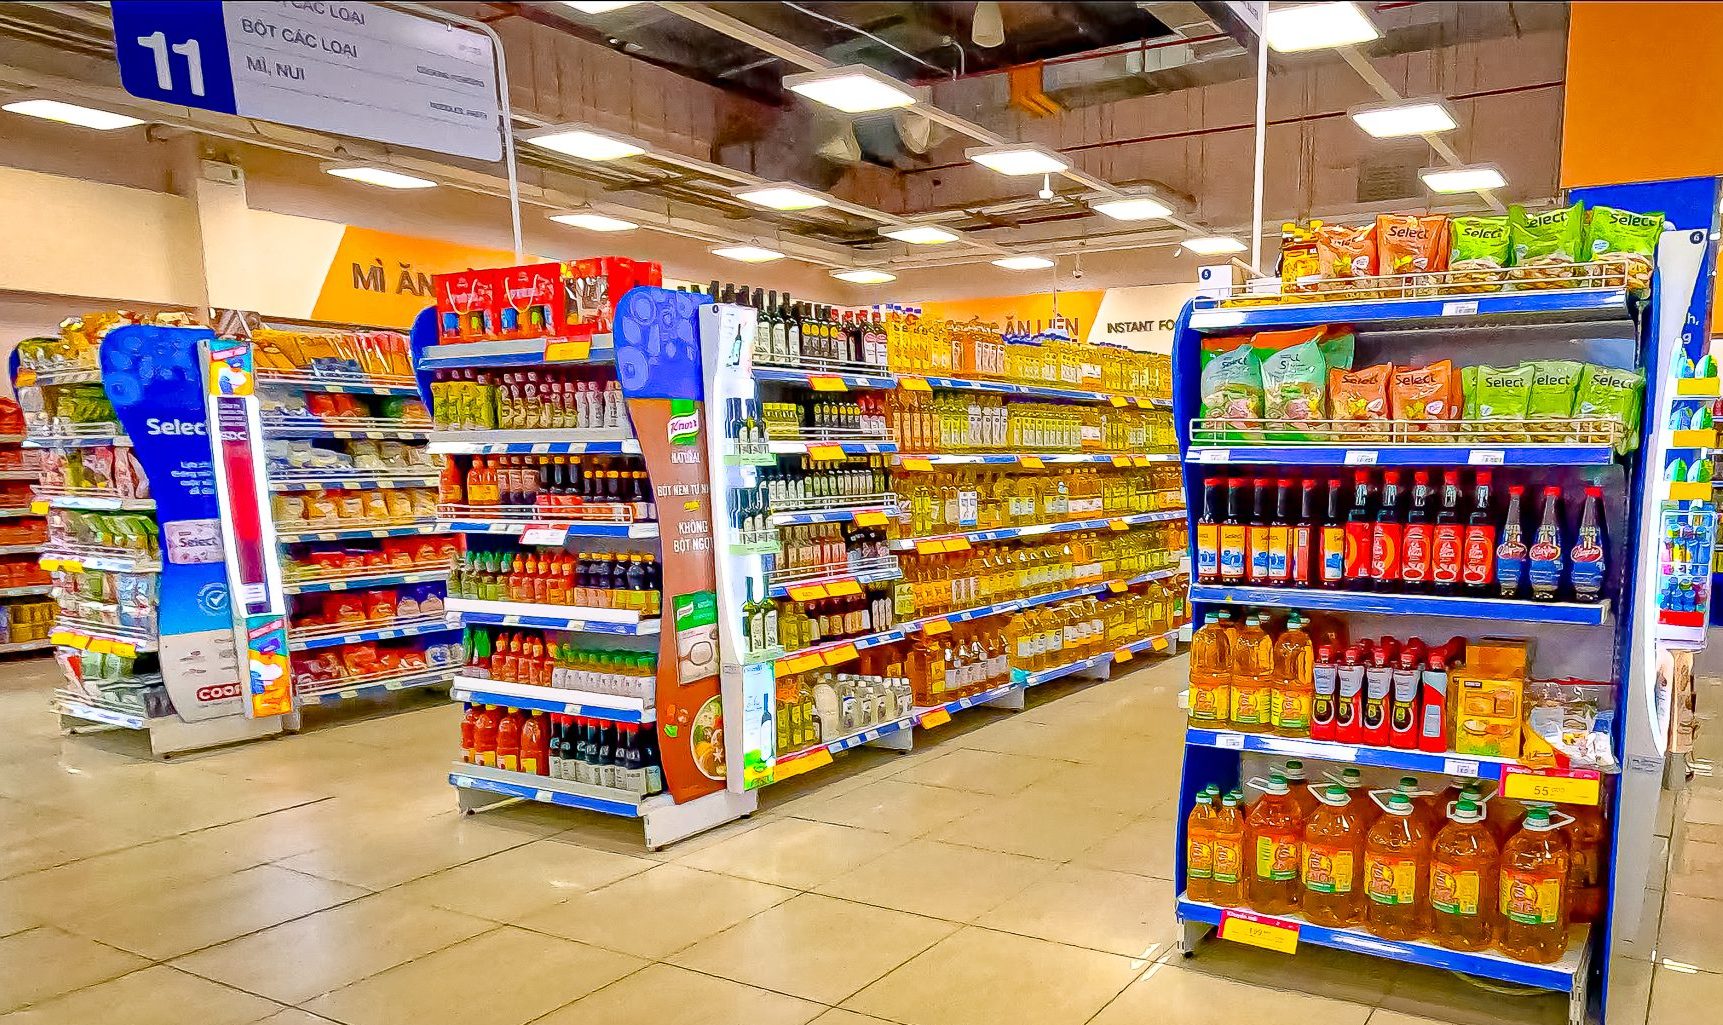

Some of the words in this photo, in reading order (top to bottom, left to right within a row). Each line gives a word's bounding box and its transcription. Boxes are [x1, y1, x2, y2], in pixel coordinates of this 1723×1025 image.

[241, 18, 277, 38] BỘT
[281, 28, 318, 49] CÁC
[321, 37, 358, 59] LOẠI
[137, 31, 205, 96] 11
[246, 56, 272, 76] MÌ,
[276, 62, 305, 80] NUI
[1388, 225, 1430, 240] Select
[1461, 227, 1504, 240] Select
[352, 257, 386, 293] MÌ
[1005, 315, 1031, 337] ĂN
[1106, 320, 1155, 334] INSTANT
[1395, 374, 1437, 385] Select
[1485, 377, 1525, 388] Select
[1534, 374, 1571, 386] elect
[678, 518, 709, 535] KHÔNG
[673, 539, 691, 554] BỘT
[1534, 785, 1549, 797] 55
